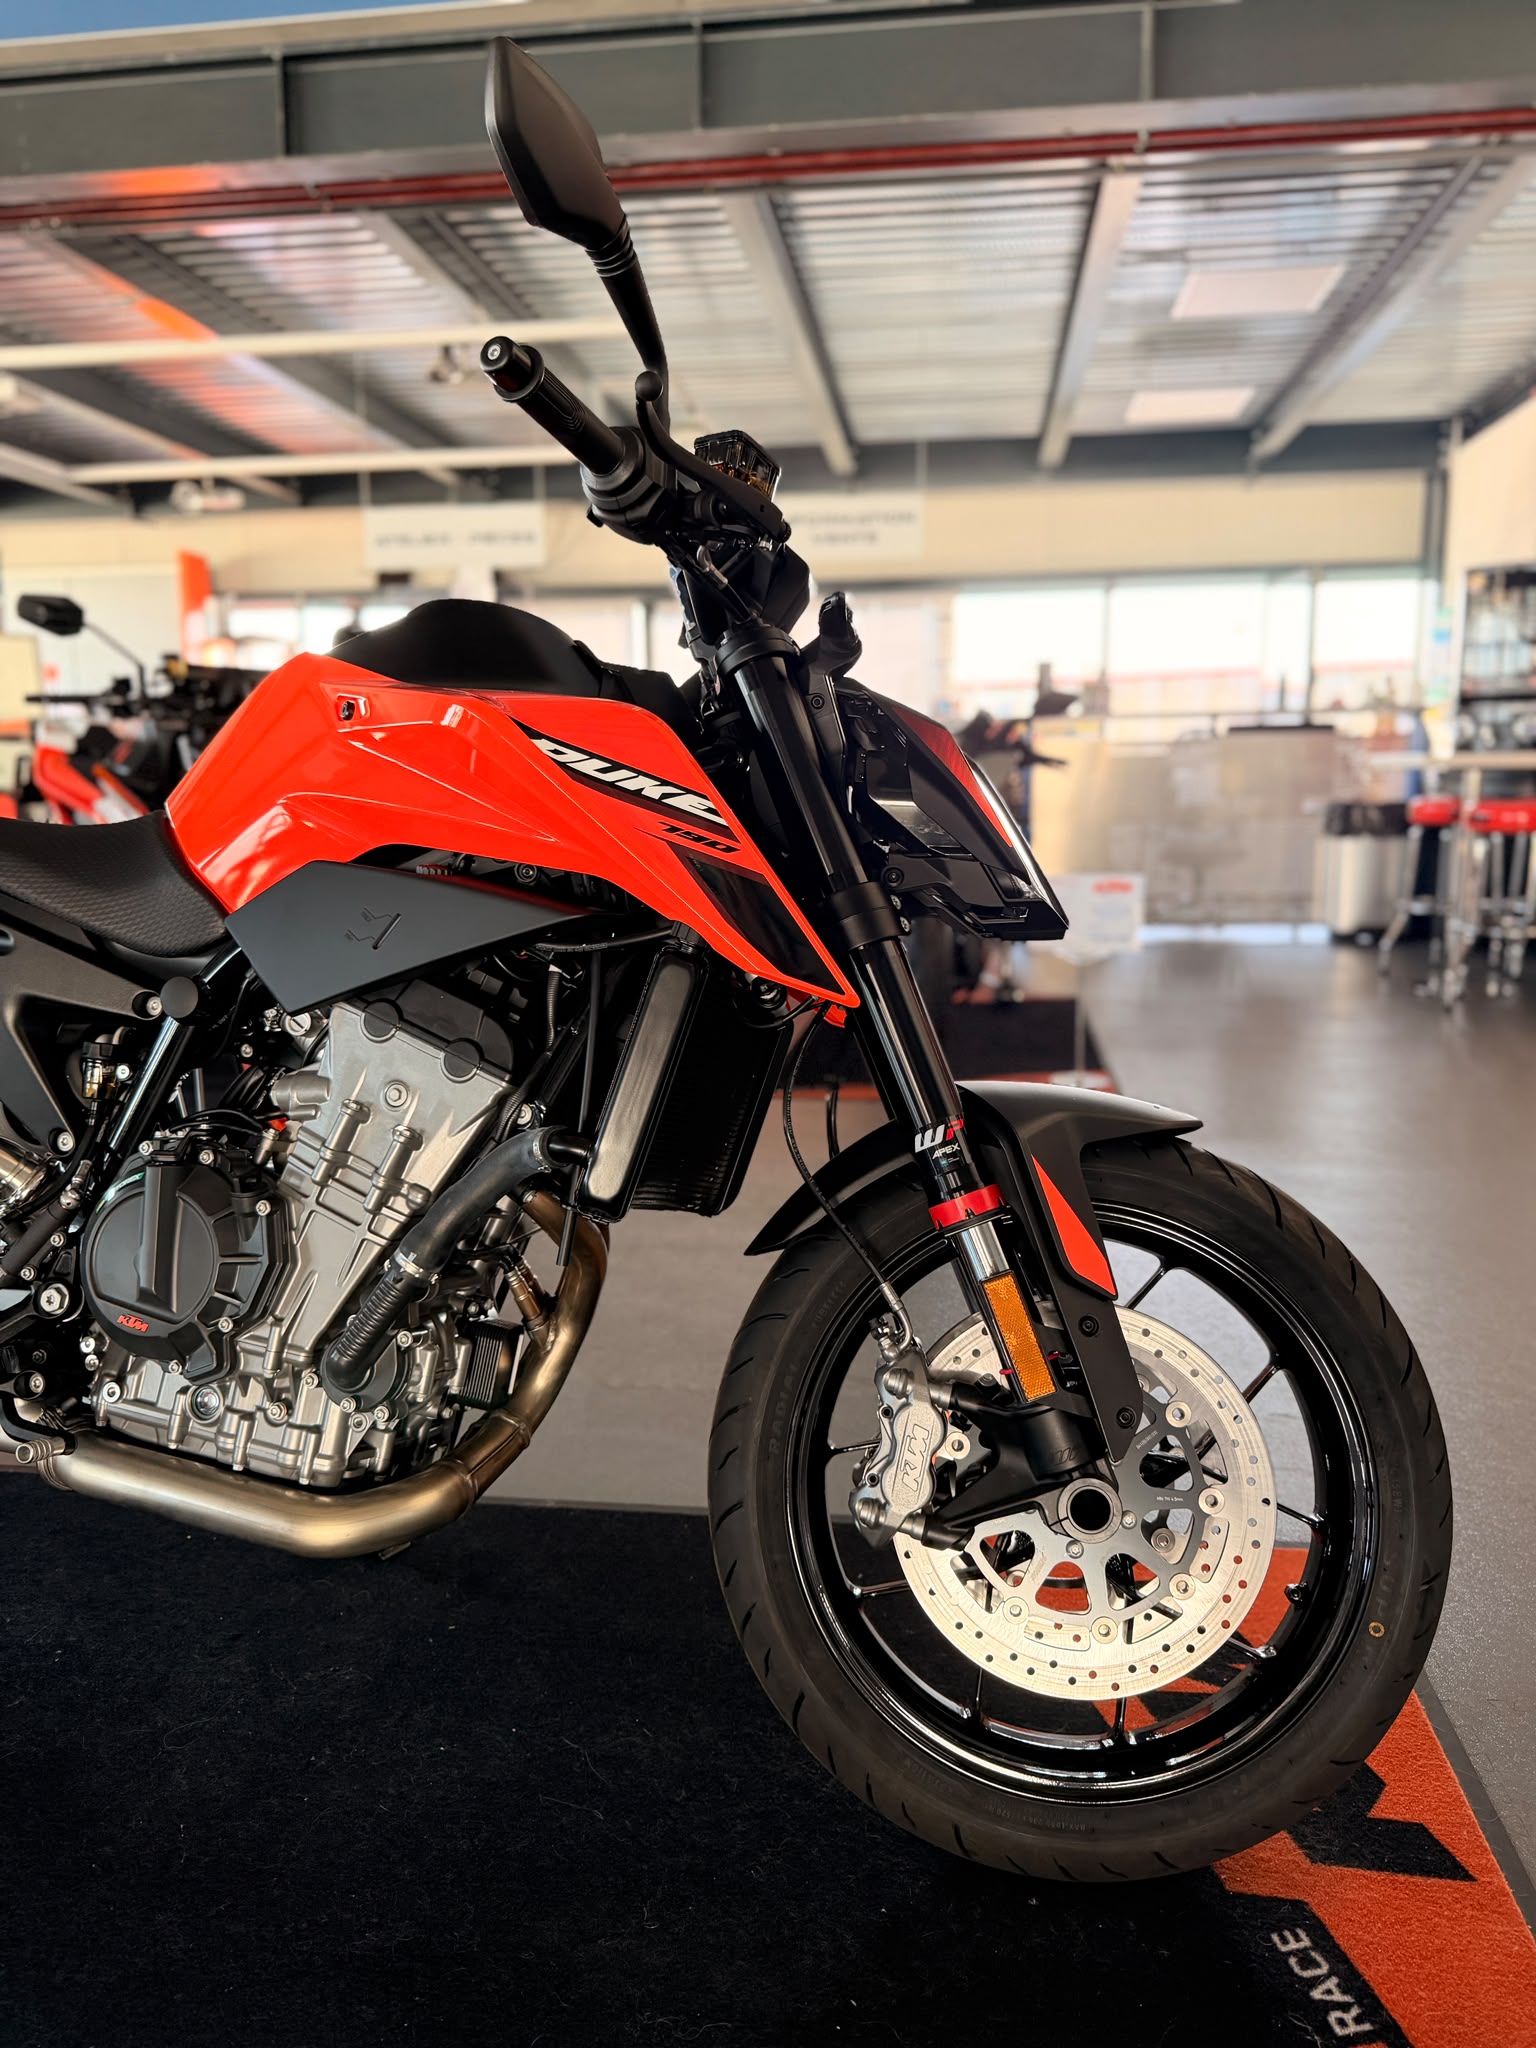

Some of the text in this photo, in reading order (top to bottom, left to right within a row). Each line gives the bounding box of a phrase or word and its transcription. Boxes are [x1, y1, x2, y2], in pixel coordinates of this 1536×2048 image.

[531, 738, 729, 826] DUKE
[658, 821, 741, 854] 790
[914, 1118, 965, 1153] WP
[932, 1142, 961, 1159] APEX
[117, 1313, 149, 1333] KTM
[900, 1423, 930, 1492] KTM
[1270, 1927, 1375, 2036] RACE
